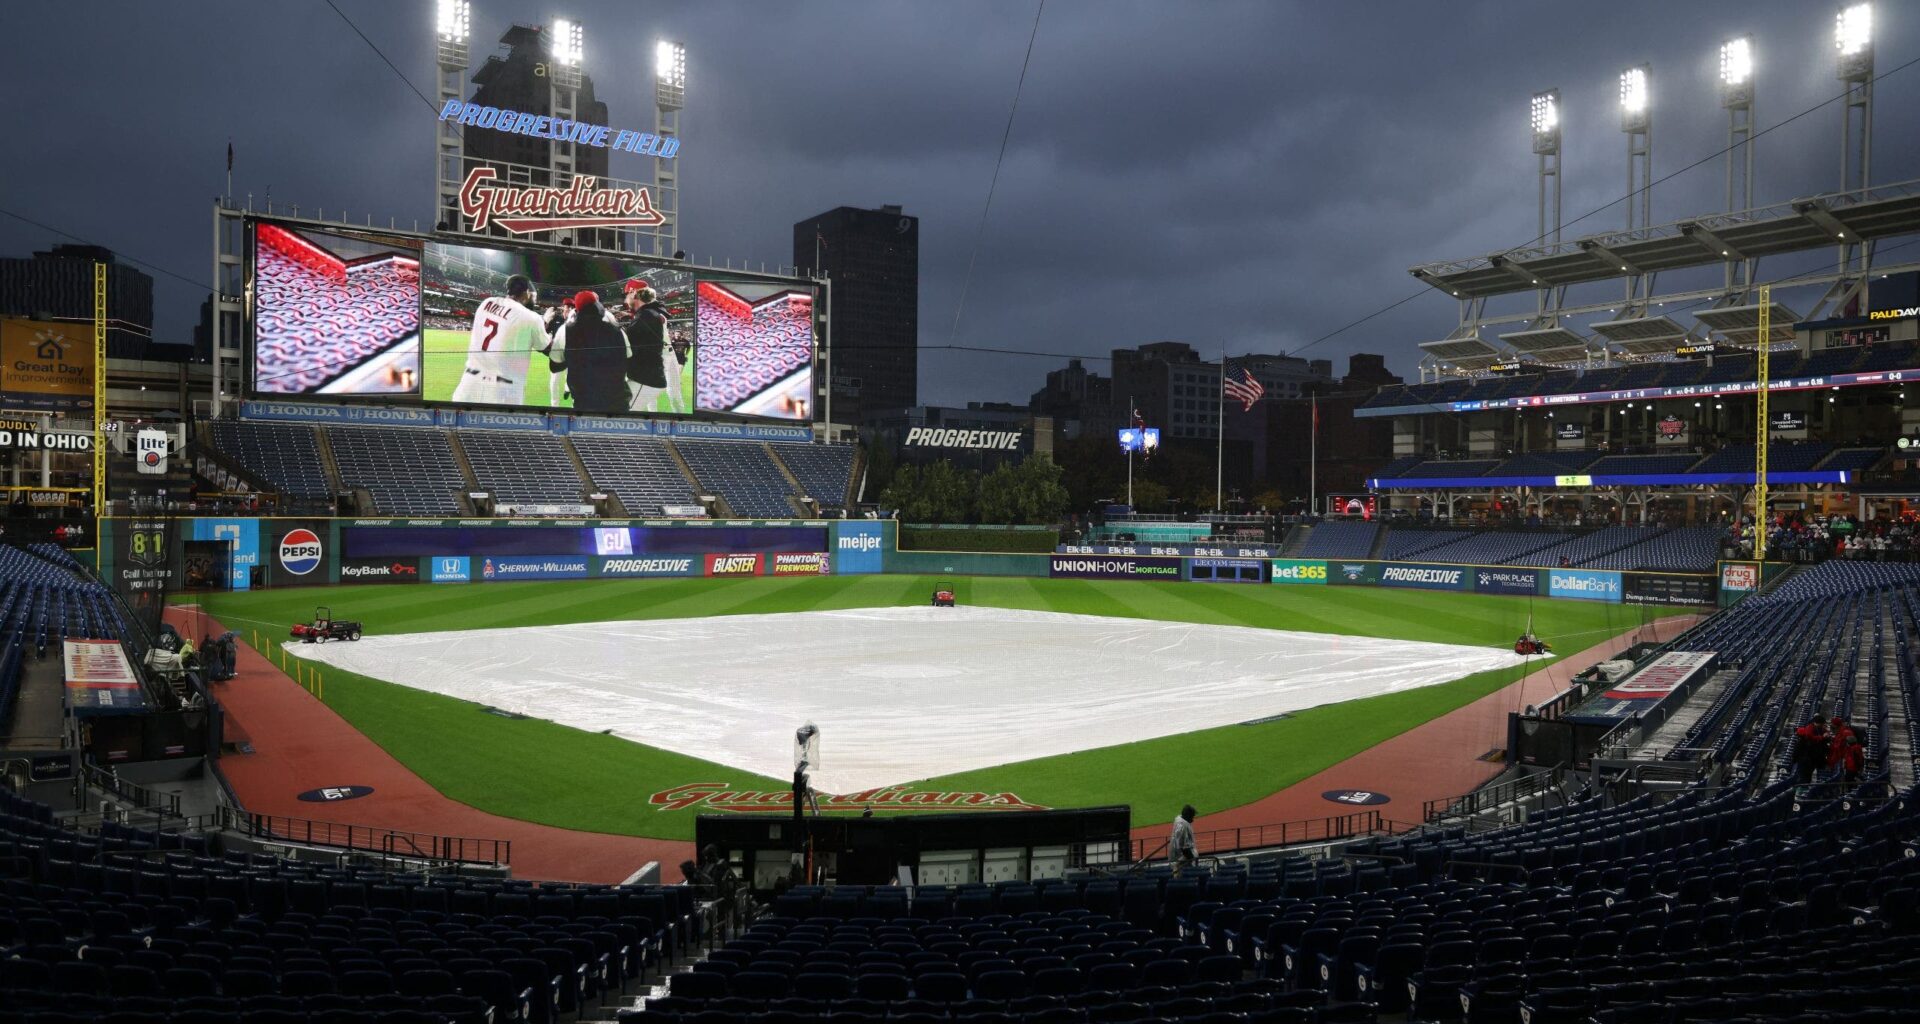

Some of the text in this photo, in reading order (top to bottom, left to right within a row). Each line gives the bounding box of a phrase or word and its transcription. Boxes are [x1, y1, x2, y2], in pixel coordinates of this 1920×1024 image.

[439, 99, 680, 159] PROGRESSIVE FIELD
[459, 167, 665, 234] Guardians
[482, 317, 499, 352] 7
[14, 360, 84, 376] Great Day
[6, 371, 89, 385] Improvements
[268, 405, 806, 438] HONDA HONDA HONDA HONDA HONDA HONDA
[18, 432, 38, 447] IN
[43, 434, 89, 449] OHIO
[140, 438, 165, 451] Lite
[905, 427, 1022, 450] PROGRESSIVE
[838, 533, 881, 551] meijer
[282, 546, 320, 557] PEPSI
[602, 559, 691, 572] PROGRESSIVE
[713, 557, 756, 573] BLASTER
[776, 555, 820, 564] PHANTOM
[1194, 559, 1228, 567] LECOM
[342, 565, 390, 577] KeyBank
[775, 564, 819, 572] FIREWORKS
[1272, 564, 1327, 579] bet365
[1383, 567, 1463, 584] PROGRESSIVE
[1724, 565, 1750, 580] drug
[1492, 573, 1535, 583] PARK PLACE
